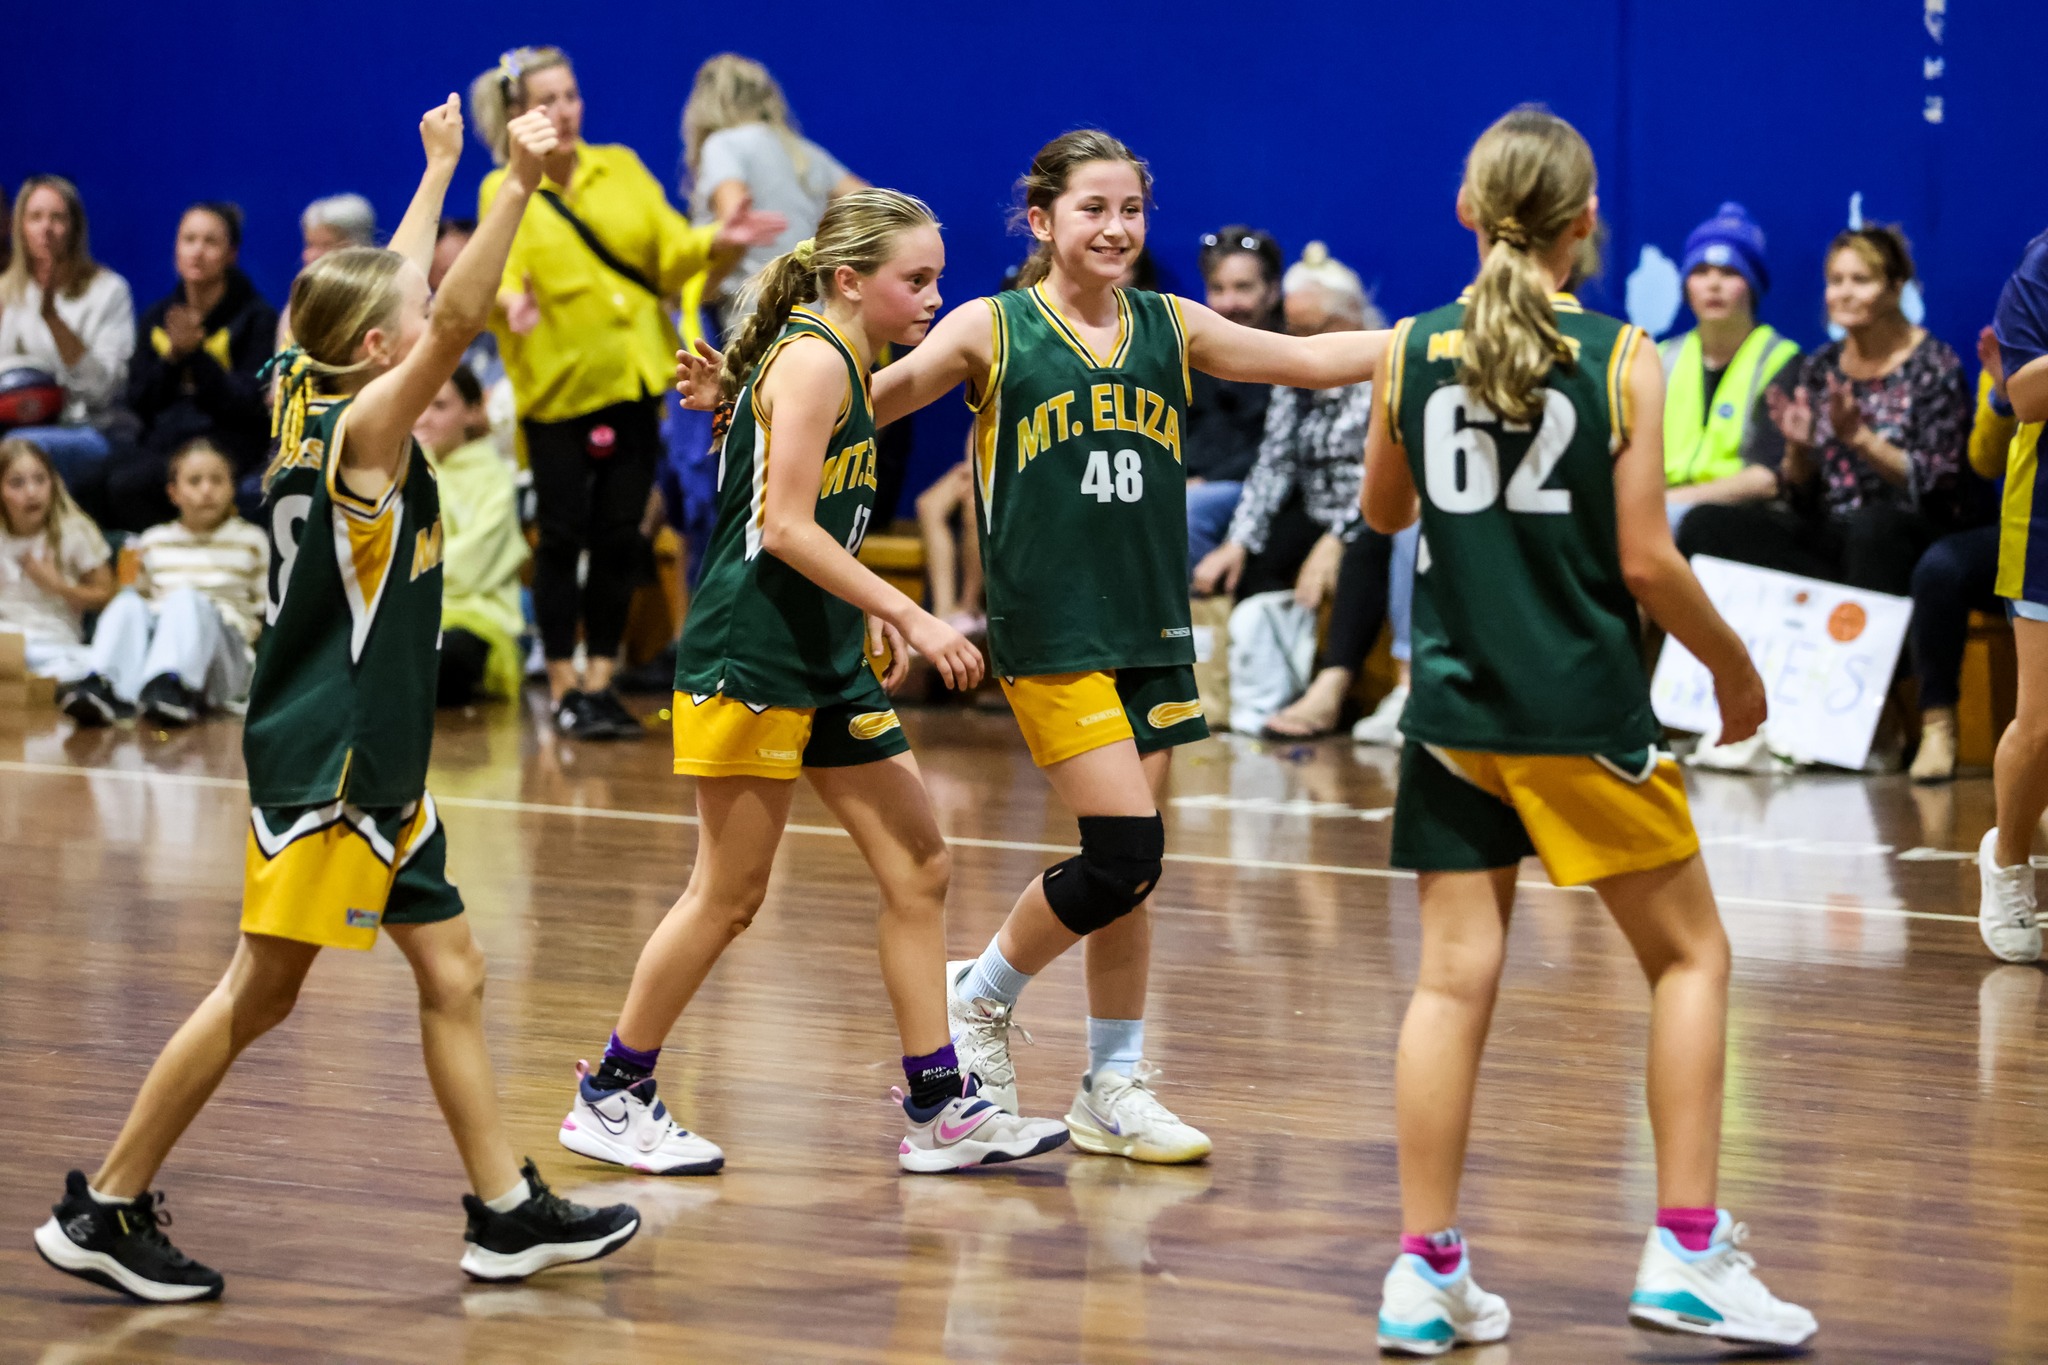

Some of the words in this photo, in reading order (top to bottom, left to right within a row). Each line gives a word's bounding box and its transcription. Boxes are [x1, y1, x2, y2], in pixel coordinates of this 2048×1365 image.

[1017, 390, 1084, 473] MT.
[1091, 383, 1182, 466] ELIZA
[1424, 384, 1577, 514] 62
[1081, 449, 1144, 503] 48
